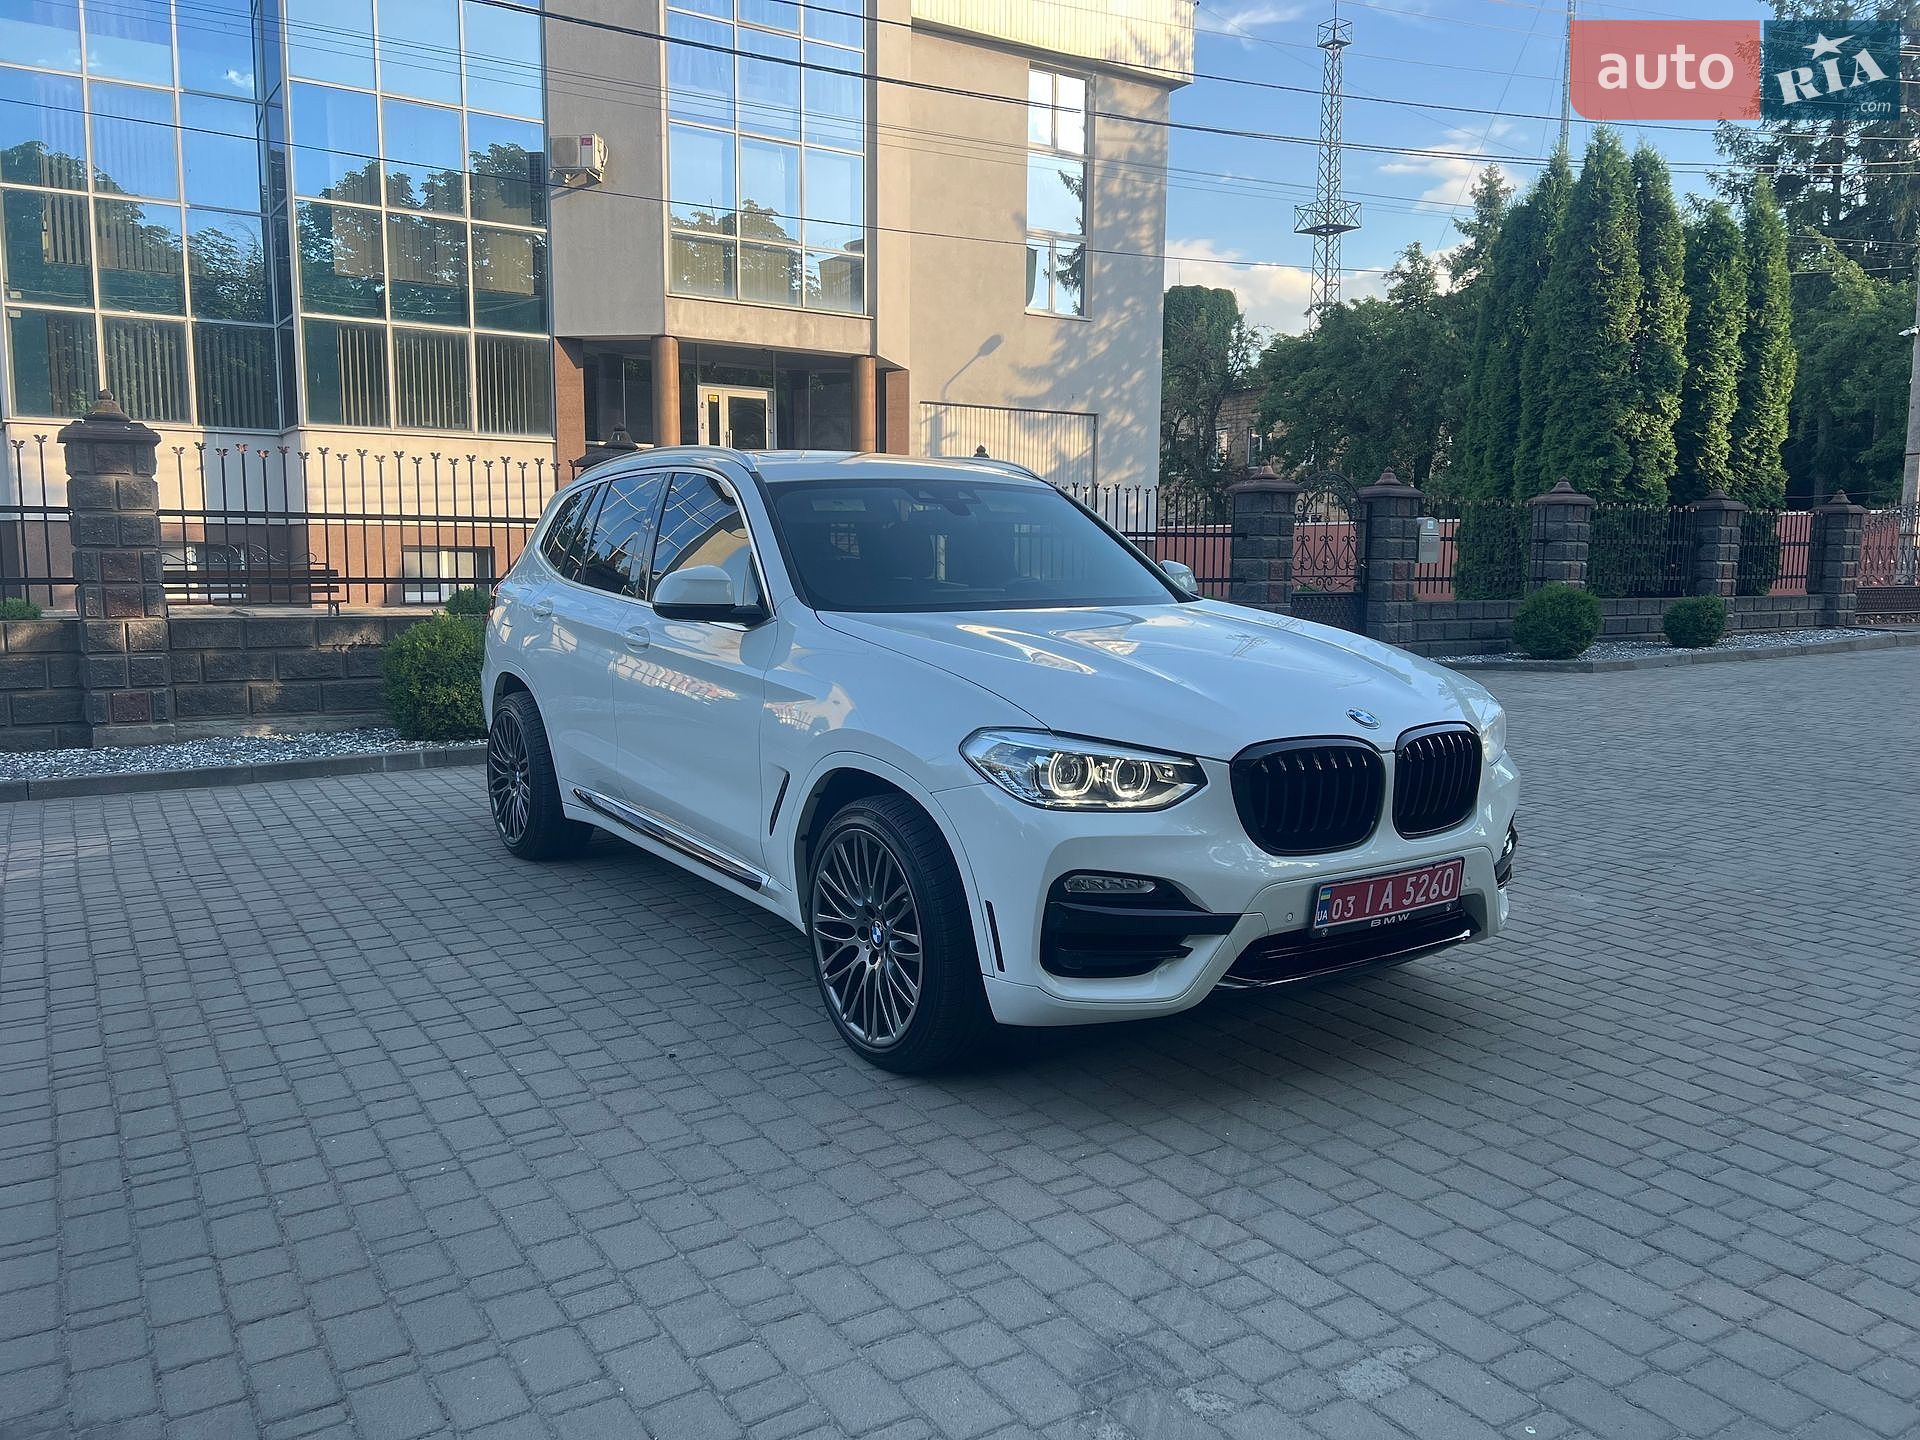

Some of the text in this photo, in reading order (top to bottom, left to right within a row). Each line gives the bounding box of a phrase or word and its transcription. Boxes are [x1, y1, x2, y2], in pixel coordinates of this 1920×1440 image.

[1332, 868, 1455, 920] 03 IA 5260
[1317, 910, 1328, 922] UA
[1370, 912, 1410, 928] BMW
